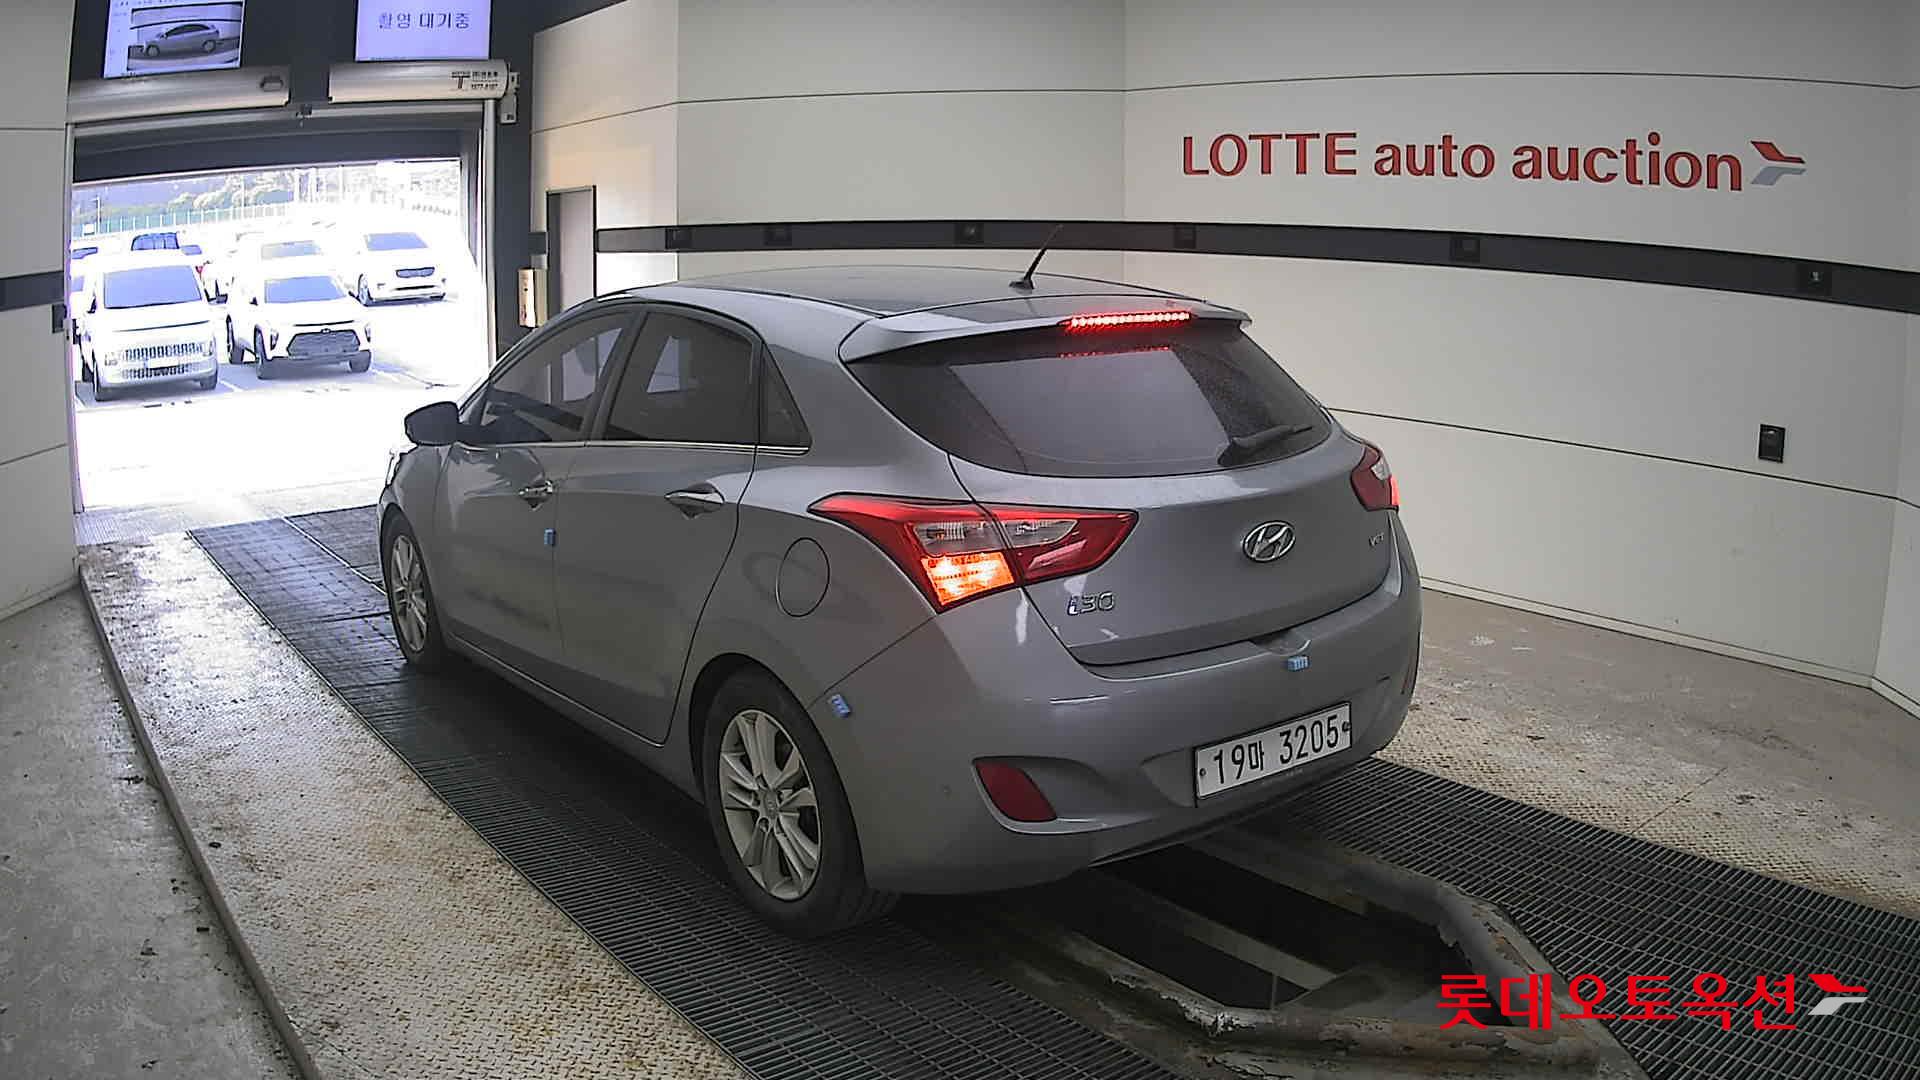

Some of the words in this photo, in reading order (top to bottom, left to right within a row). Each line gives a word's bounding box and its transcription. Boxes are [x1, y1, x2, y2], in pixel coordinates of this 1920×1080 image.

[419, 12, 470, 29] 대기중
[1183, 132, 1357, 176] LOTTE
[1374, 134, 1496, 178] auto
[1511, 132, 1743, 192] auction
[1213, 740, 1265, 784] 19마
[1279, 715, 1339, 764] 3205
